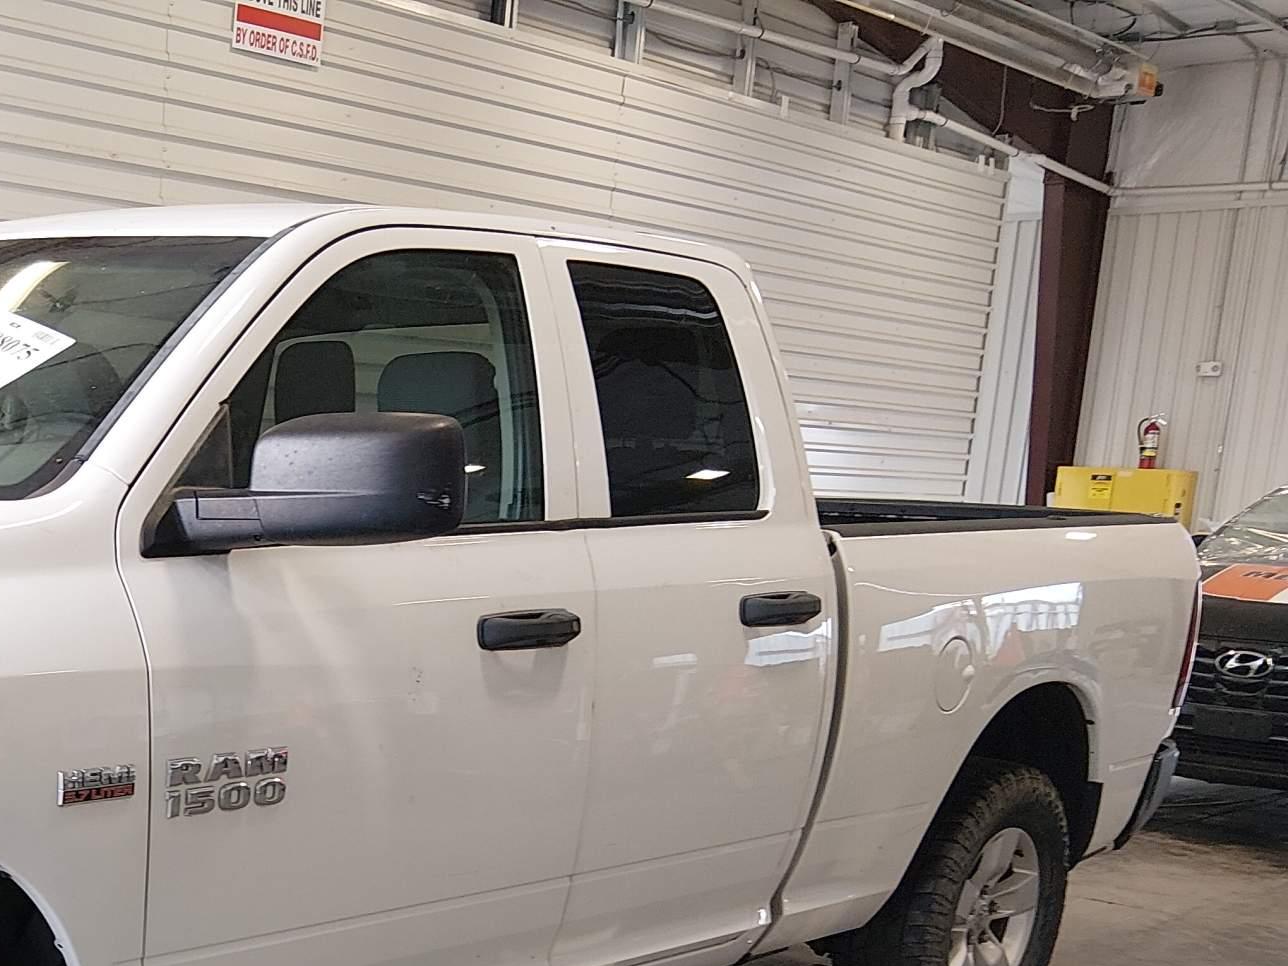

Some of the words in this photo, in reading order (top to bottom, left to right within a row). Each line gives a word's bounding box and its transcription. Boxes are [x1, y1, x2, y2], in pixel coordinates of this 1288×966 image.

[301, 0, 321, 18] LINE
[235, 27, 248, 45] BY
[249, 30, 278, 53] ORDER
[279, 37, 290, 55] OF
[167, 746, 288, 788] RAM
[167, 778, 287, 819] 1500
